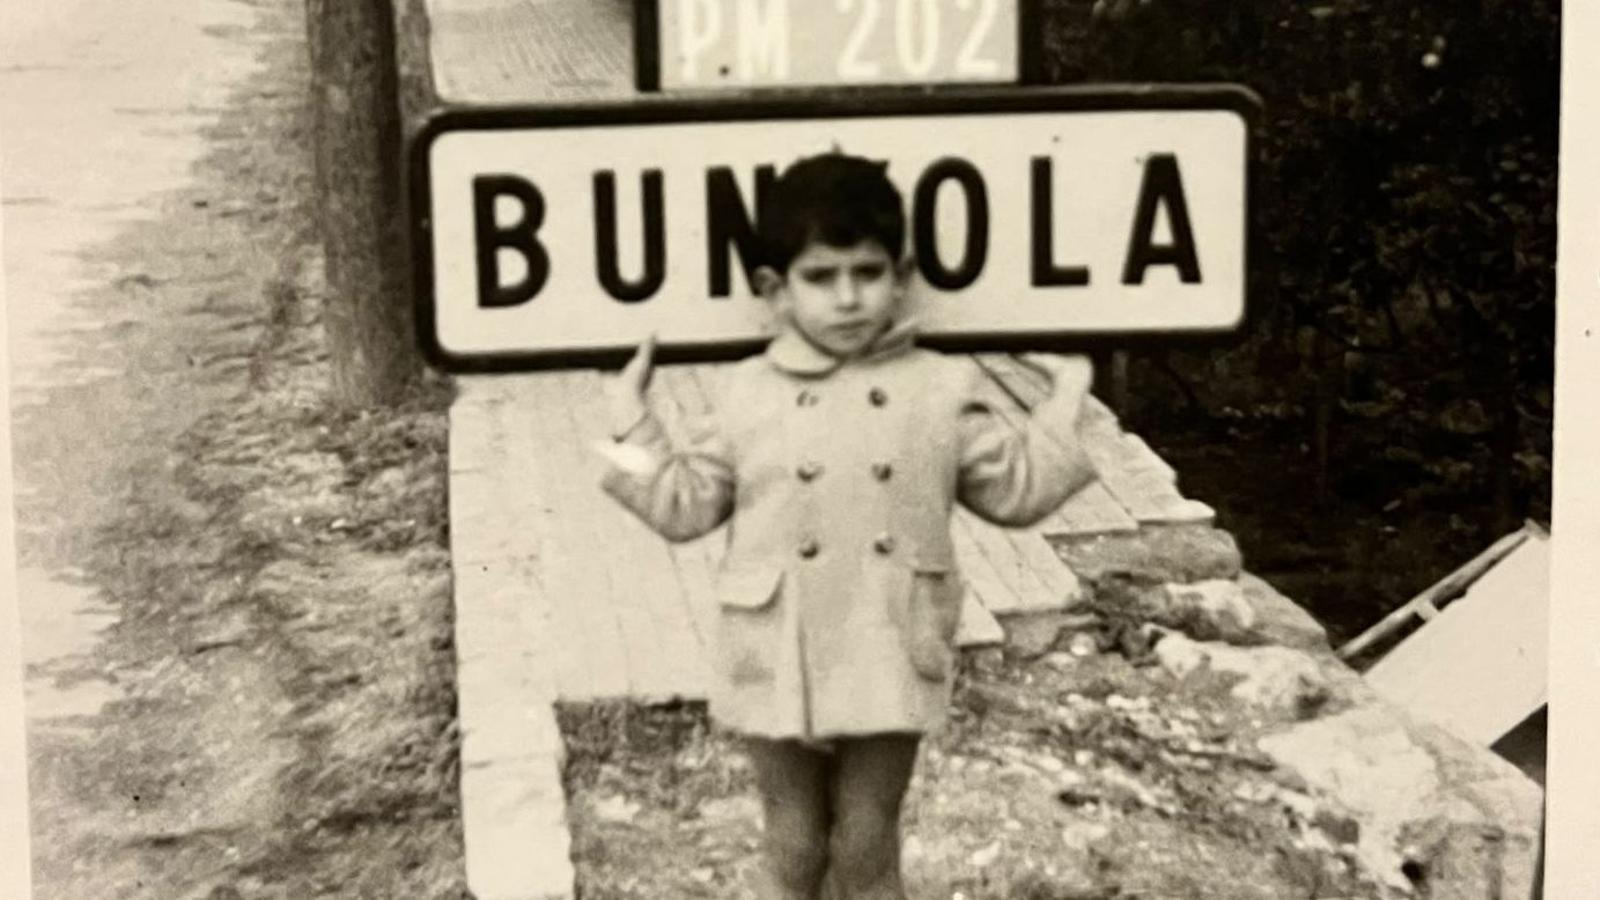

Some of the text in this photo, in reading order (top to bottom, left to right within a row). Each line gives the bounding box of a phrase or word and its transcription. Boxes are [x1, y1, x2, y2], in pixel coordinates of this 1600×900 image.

[680, 0, 1001, 81] PM 202
[472, 152, 1203, 308] BUNOLA
